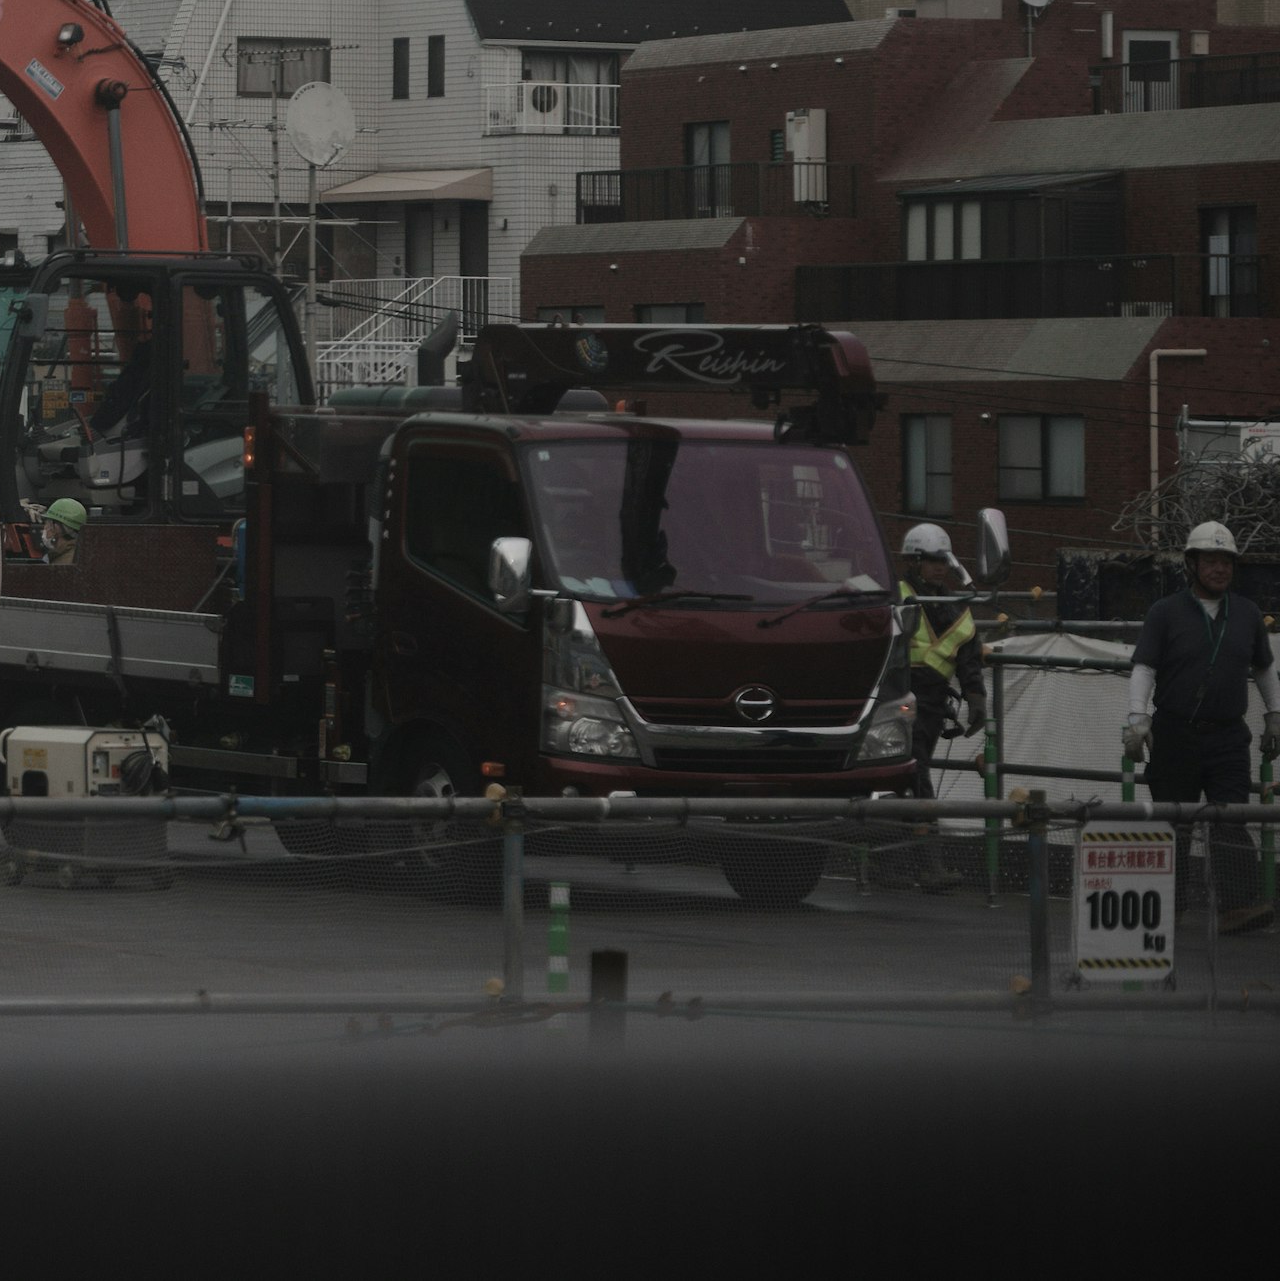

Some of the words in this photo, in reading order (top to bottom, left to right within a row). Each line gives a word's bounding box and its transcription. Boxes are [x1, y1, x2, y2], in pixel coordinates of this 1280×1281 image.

[633, 329, 786, 385] Reishin
[1086, 890, 1161, 930] 1000
[1143, 933, 1166, 953] kg
